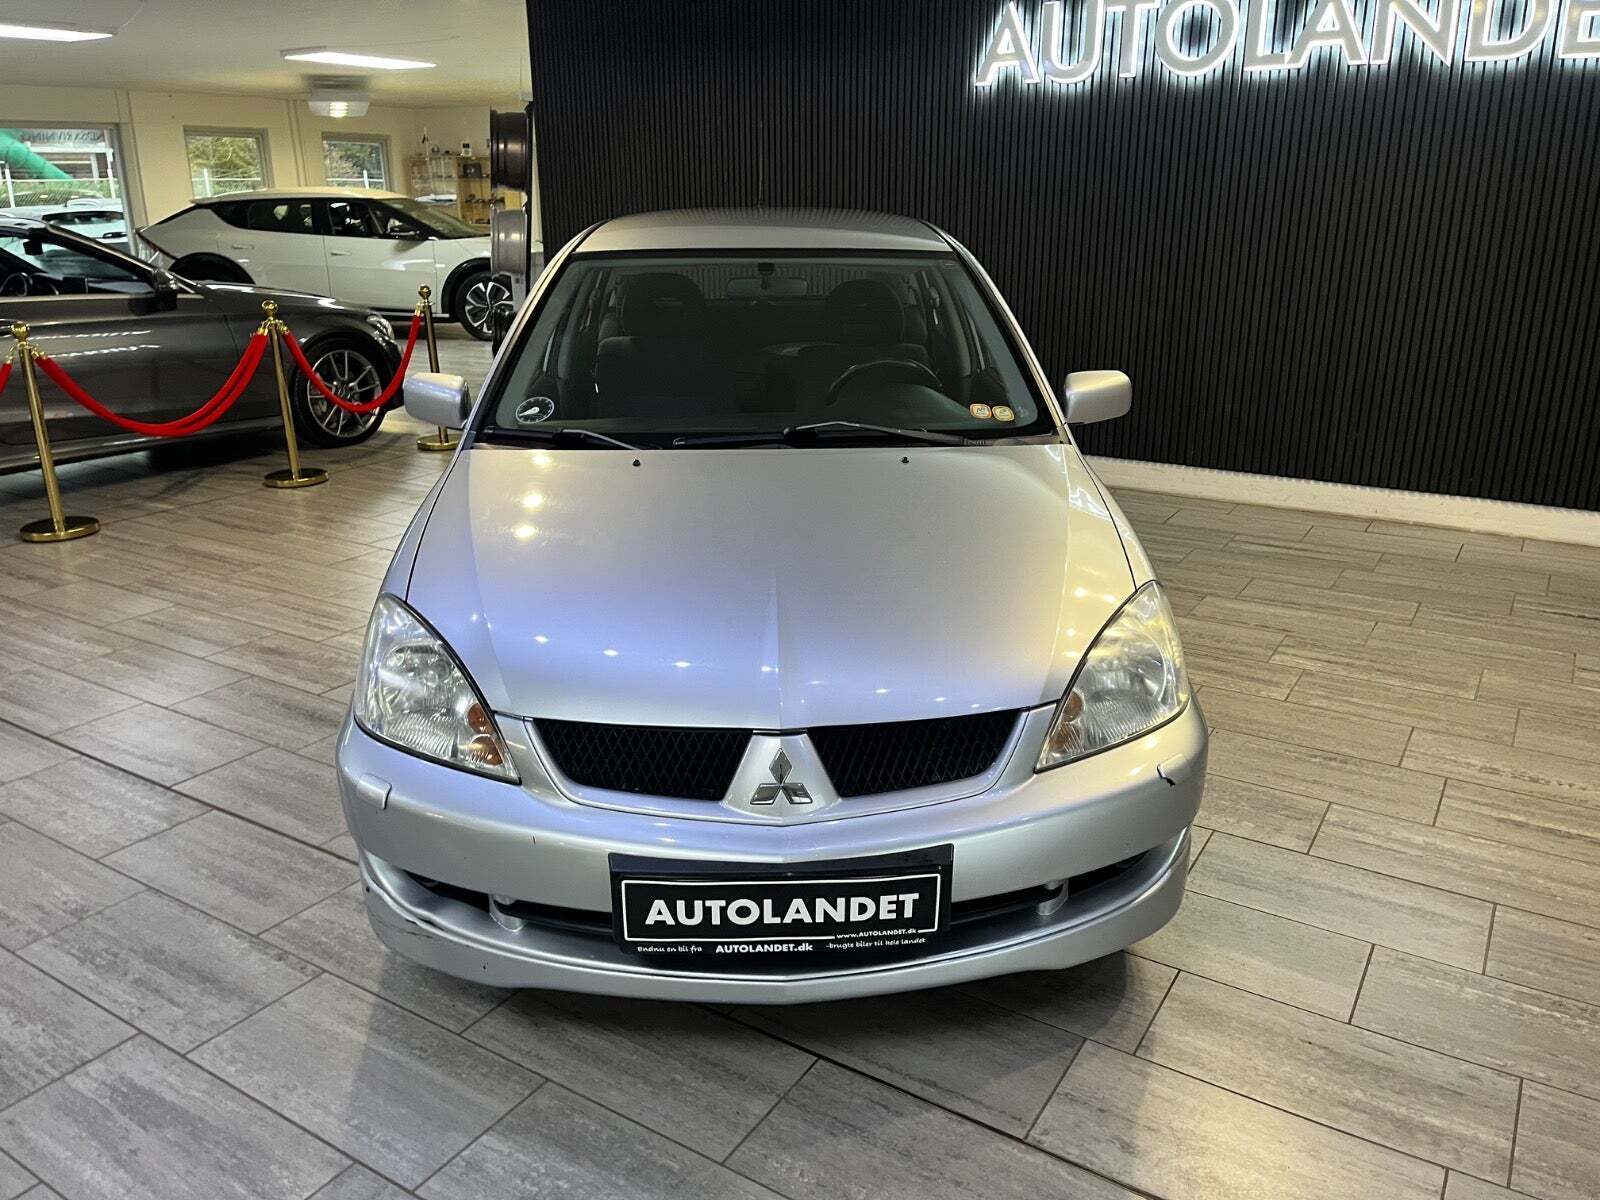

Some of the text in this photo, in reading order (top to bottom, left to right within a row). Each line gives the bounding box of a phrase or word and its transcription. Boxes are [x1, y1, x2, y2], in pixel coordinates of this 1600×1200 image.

[645, 893, 920, 926] AUTOLANDET
[836, 928, 917, 938] www.AUTOLANDET.dk
[690, 946, 703, 955] fra
[715, 942, 813, 954] AUTOLANDET.dk
[874, 938, 883, 947] til
[901, 937, 927, 945] landet
